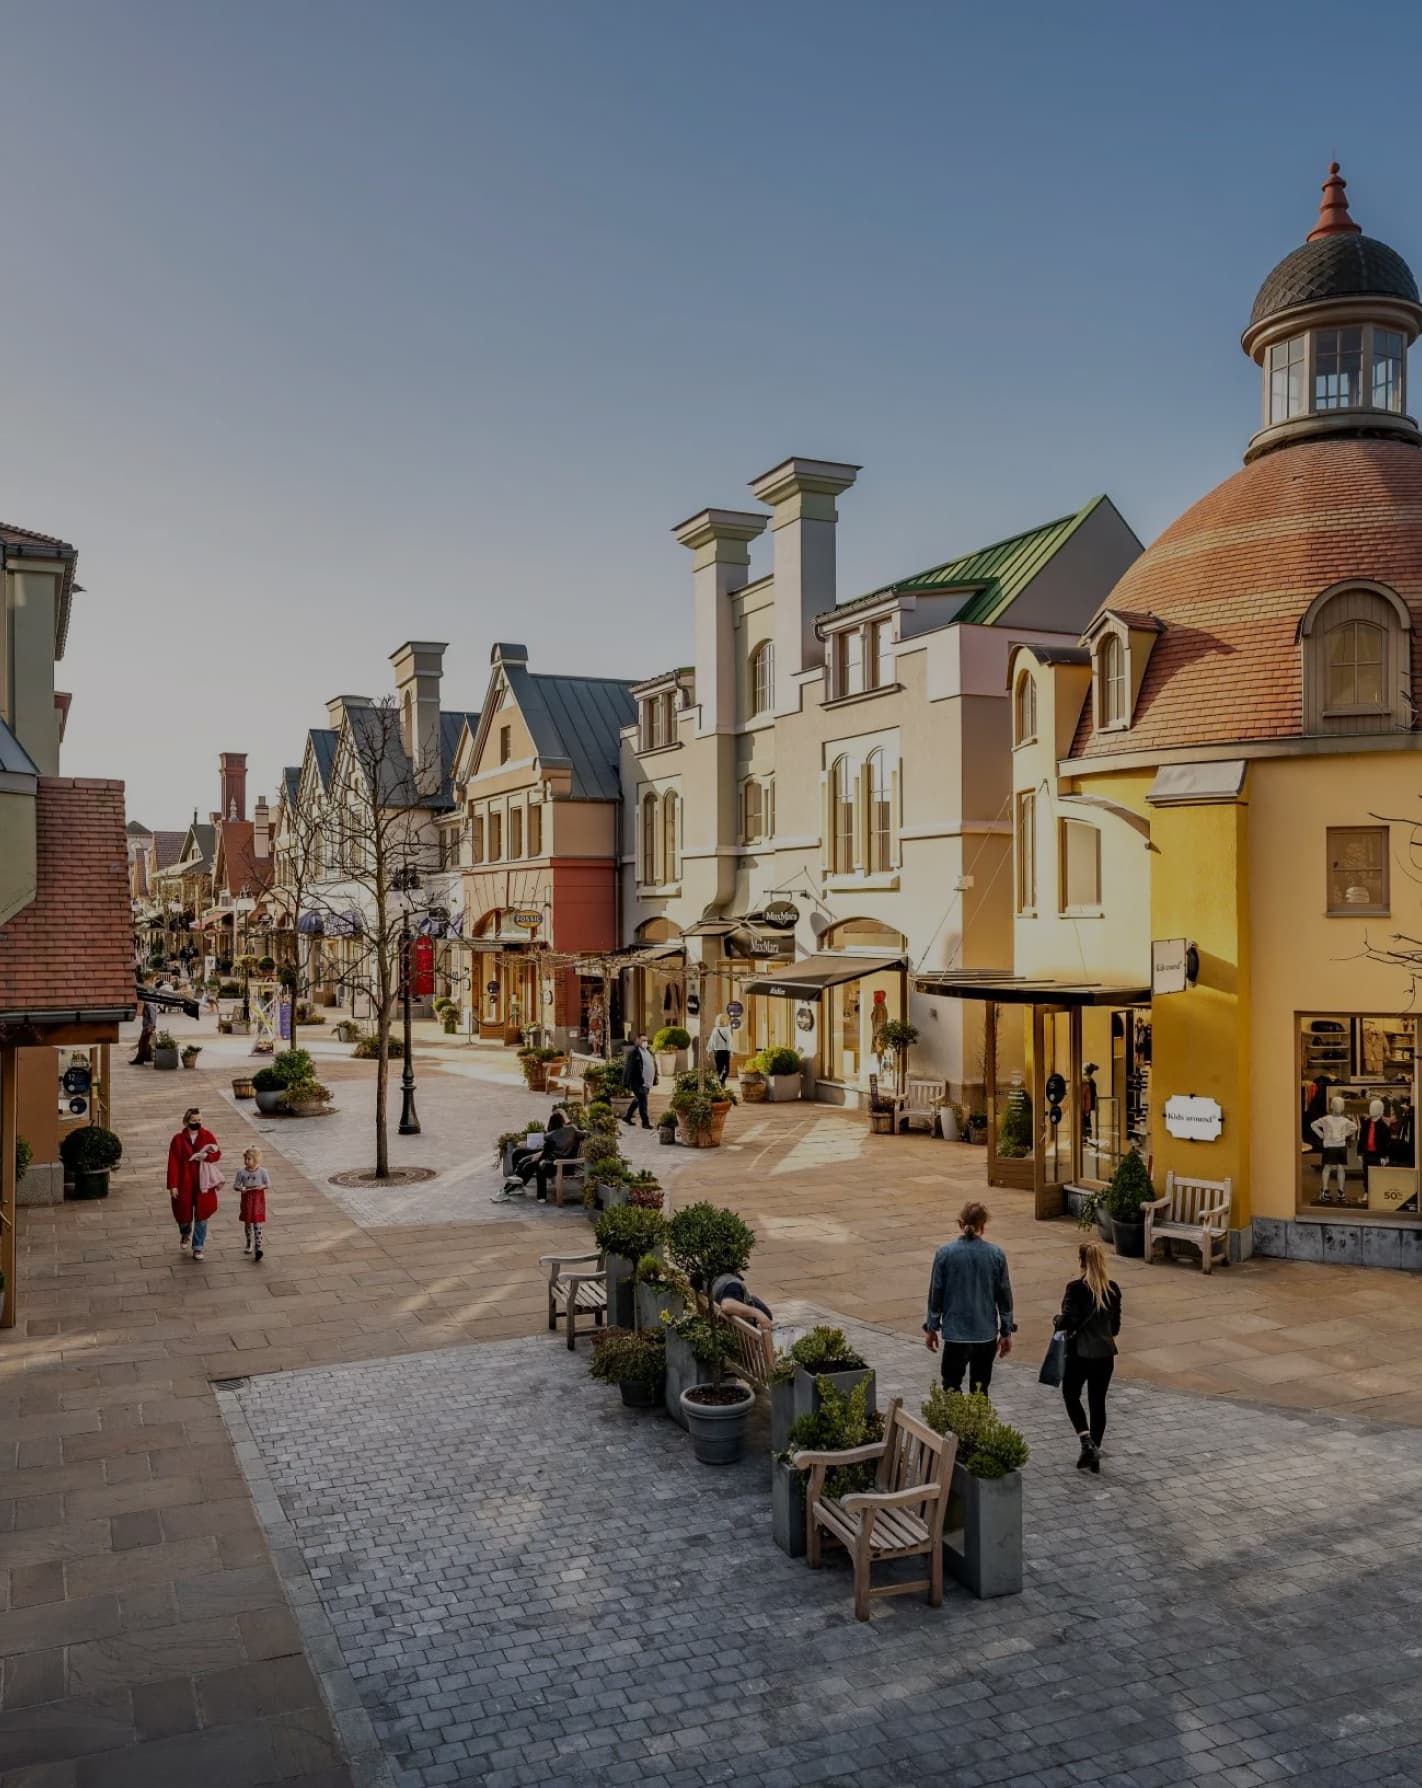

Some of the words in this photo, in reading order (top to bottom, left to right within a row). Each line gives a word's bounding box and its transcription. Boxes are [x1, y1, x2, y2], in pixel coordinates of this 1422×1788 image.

[515, 914, 541, 923] FOSSIL
[766, 911, 797, 921] MaxMara
[1167, 1112, 1185, 1121] Kids
